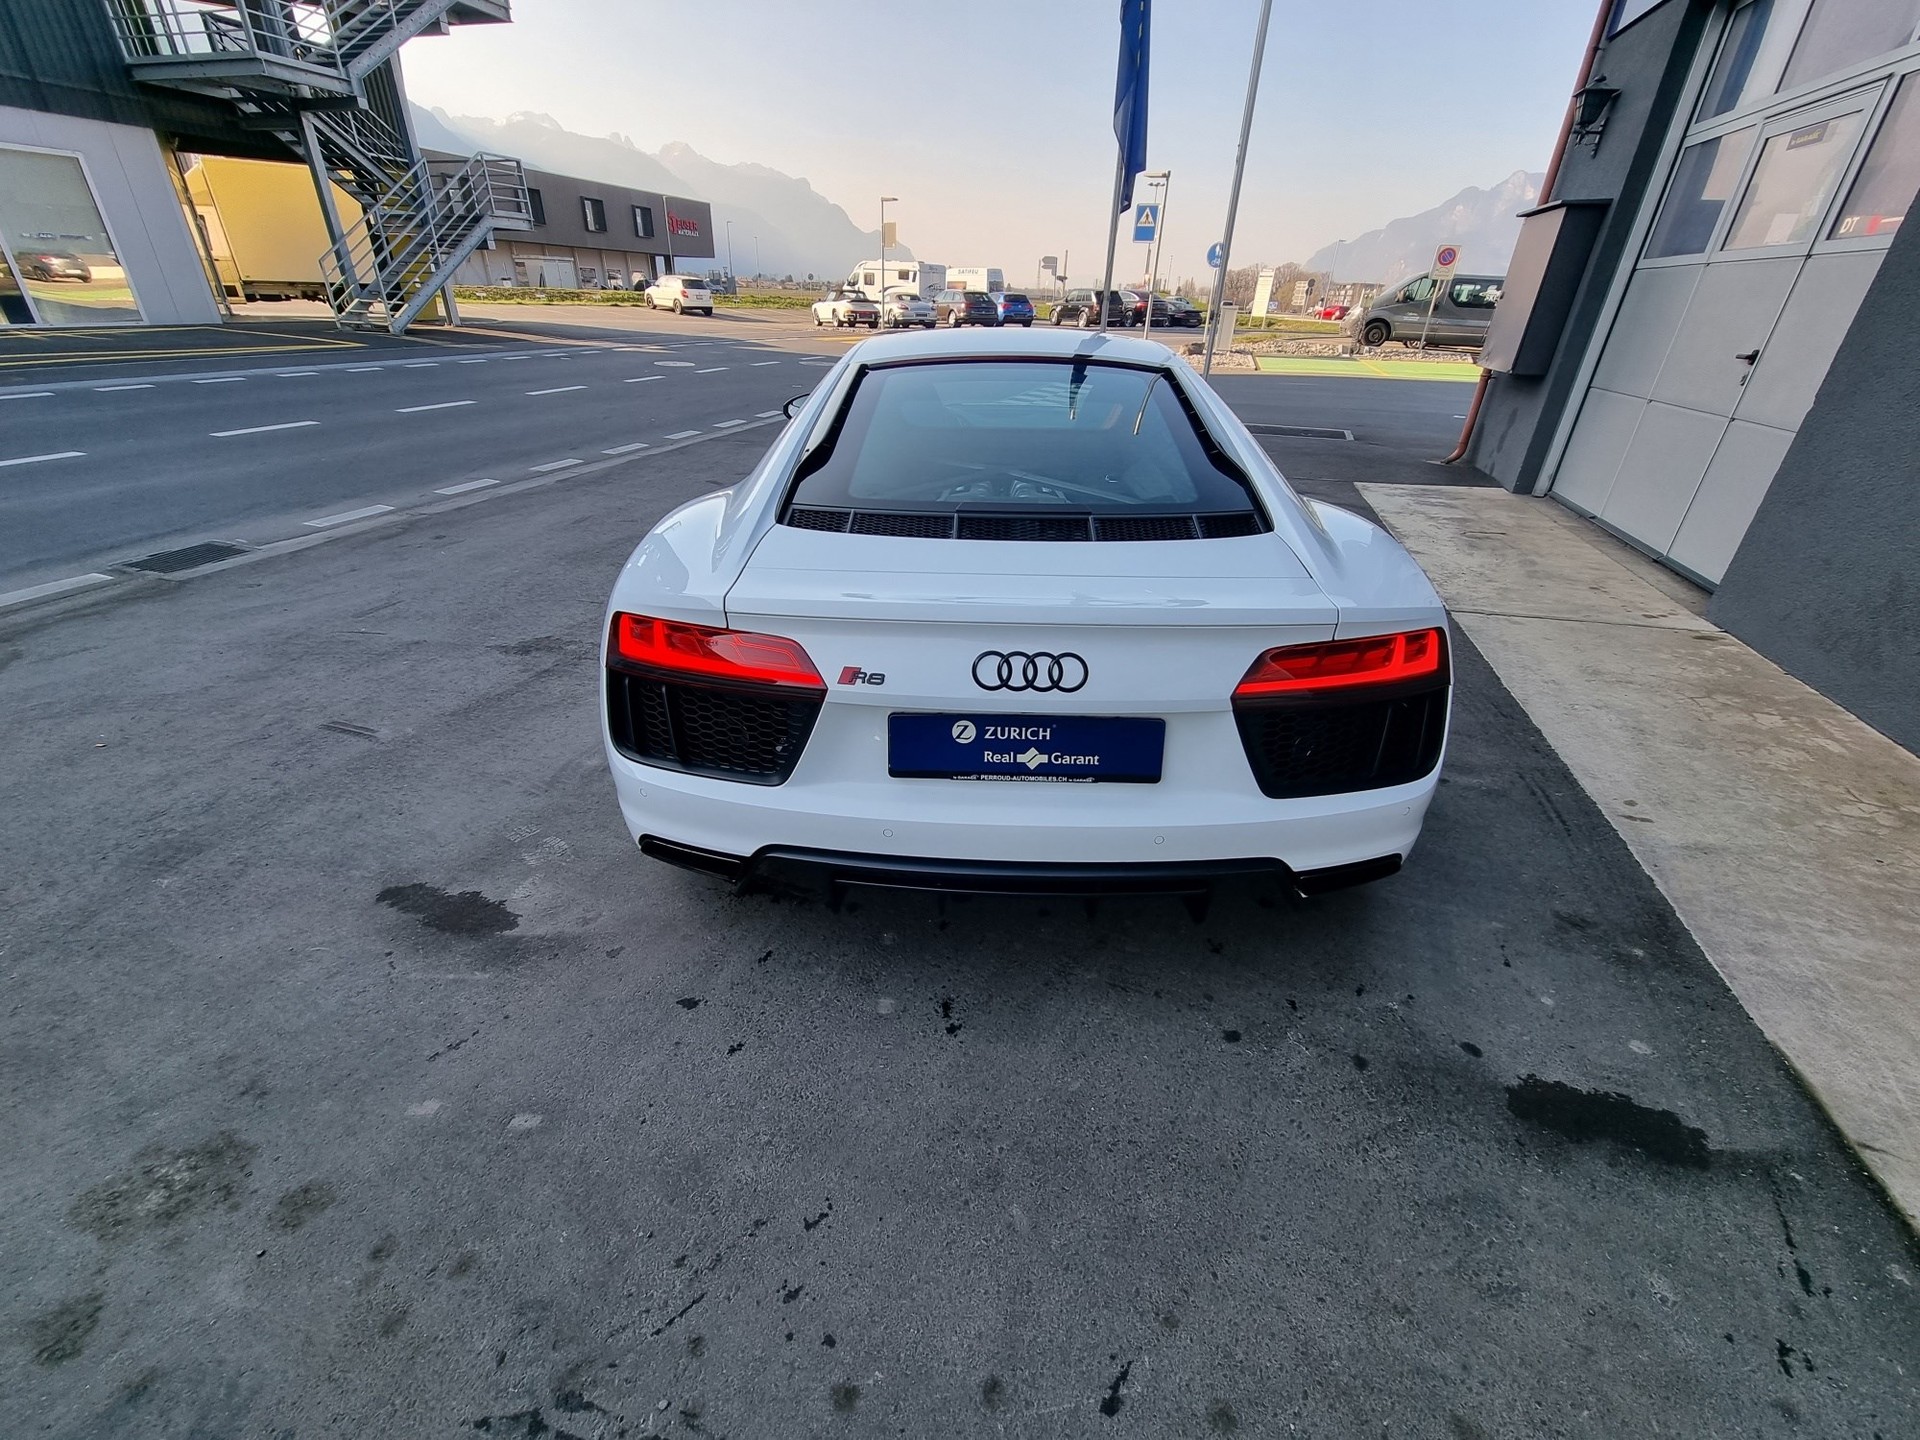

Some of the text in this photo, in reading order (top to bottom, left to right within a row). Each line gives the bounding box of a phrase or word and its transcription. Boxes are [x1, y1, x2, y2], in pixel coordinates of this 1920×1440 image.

[848, 670, 886, 686] R8
[983, 726, 1051, 740] ZURICH
[983, 751, 1100, 766] Real Garant
[980, 774, 1068, 783] PERROUD-AUTOMOBILES.CH
